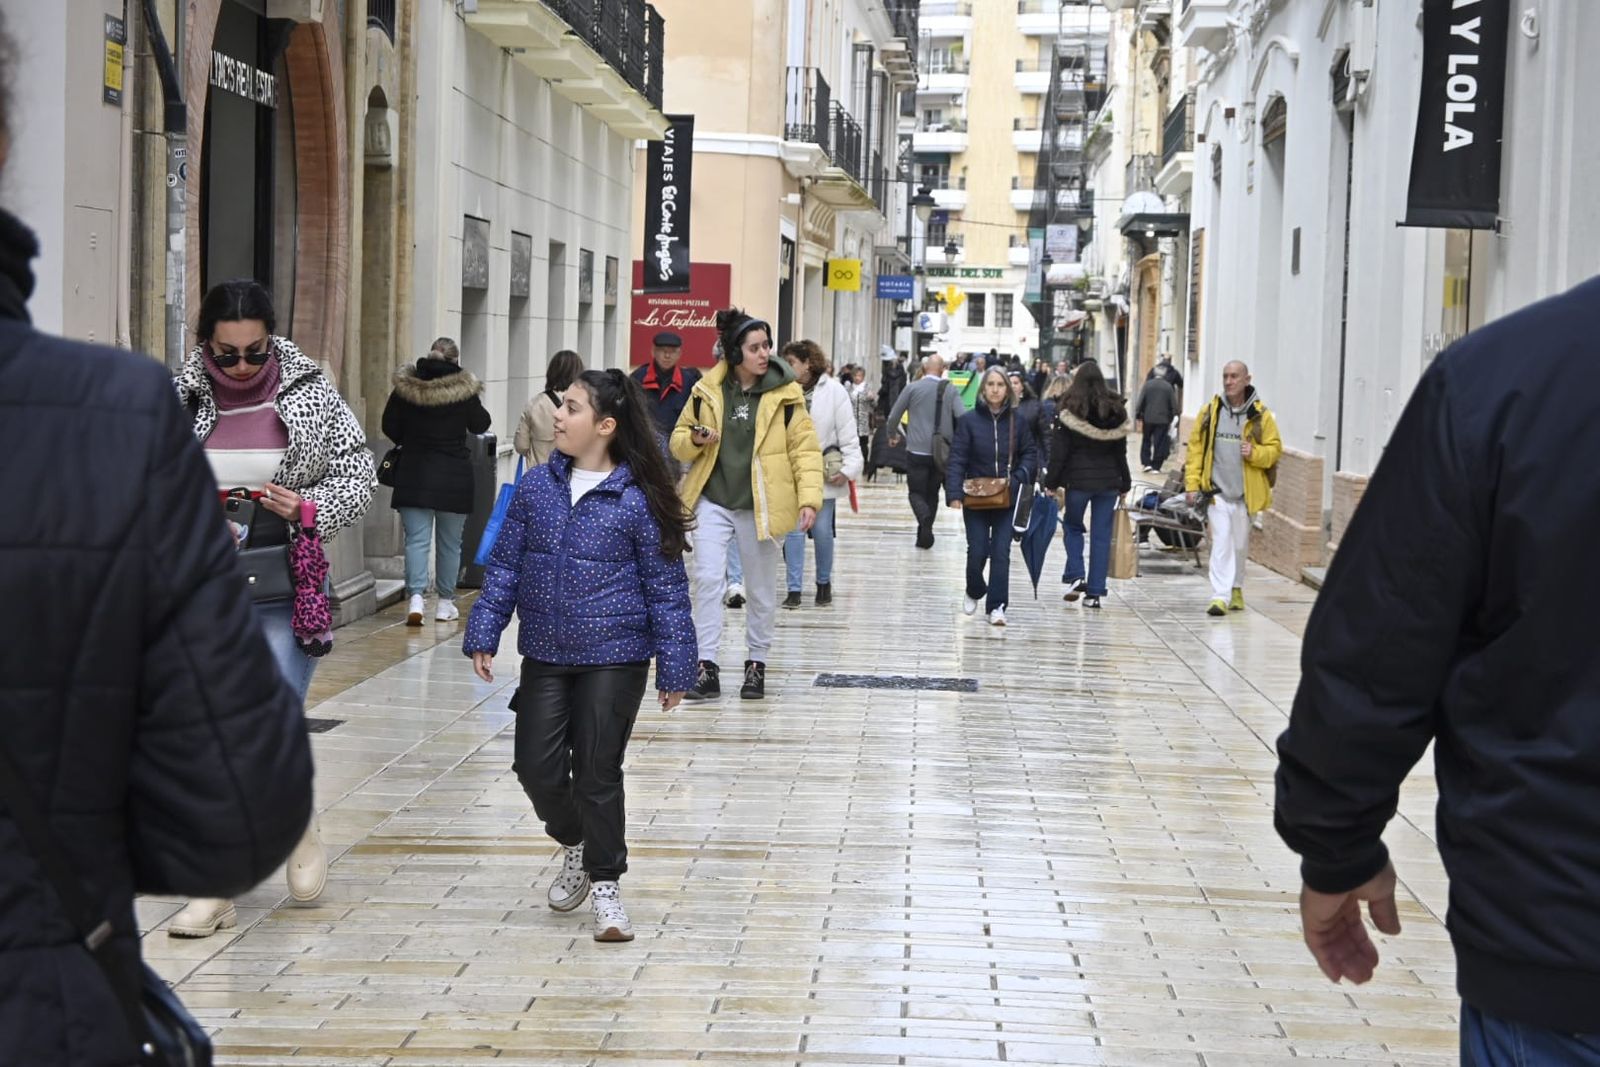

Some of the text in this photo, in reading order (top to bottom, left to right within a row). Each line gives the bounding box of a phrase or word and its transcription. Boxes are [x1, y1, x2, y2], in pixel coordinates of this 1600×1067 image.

[1450, 16, 1481, 45] Y
[236, 60, 254, 101] REAL
[1443, 54, 1479, 152] LOLA
[661, 128, 675, 181] VIAJES
[960, 268, 980, 278] DEL
[982, 268, 1003, 279] SUR
[634, 308, 718, 330] La Tagliatell
